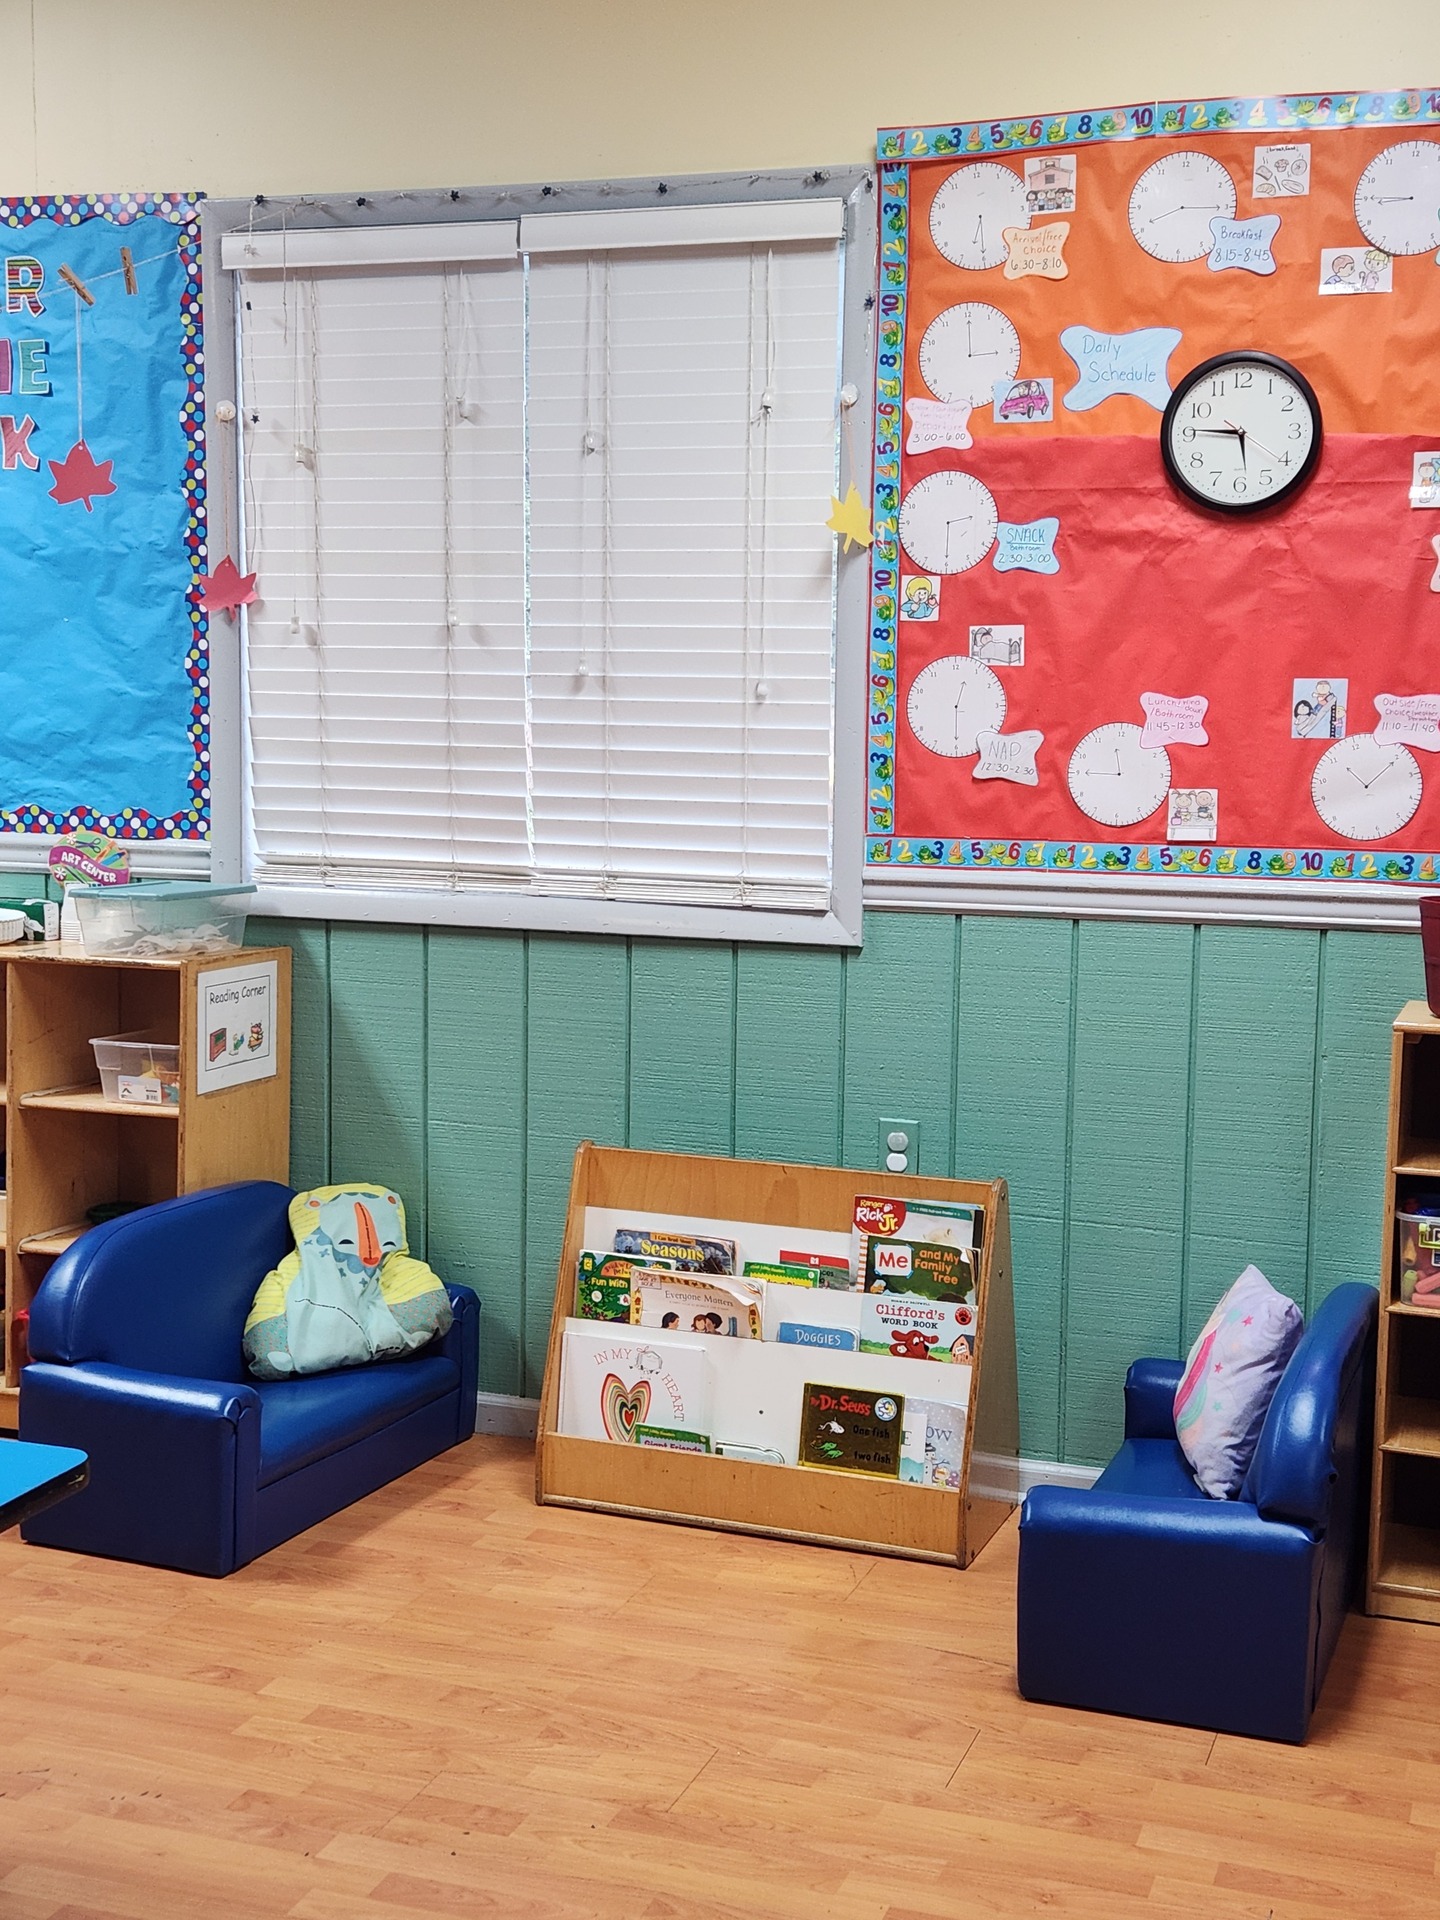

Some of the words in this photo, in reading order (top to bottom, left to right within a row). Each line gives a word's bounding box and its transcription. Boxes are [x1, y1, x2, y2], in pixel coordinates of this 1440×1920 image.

[1176, 104, 1187, 125] 1
[1192, 104, 1208, 124] 2
[1231, 101, 1245, 121] 3
[1251, 100, 1265, 118] 4
[1276, 99, 1290, 119] 5
[1317, 97, 1333, 117] 6
[1346, 95, 1360, 116] 7
[1370, 96, 1384, 115] 8
[1407, 93, 1421, 113] 9
[896, 131, 906, 152] 1
[911, 131, 927, 150] 2
[950, 127, 963, 147] 3
[967, 125, 980, 144] 4
[990, 123, 1004, 144] 5
[1029, 119, 1043, 139] 6
[1056, 116, 1068, 136] 7
[1078, 115, 1092, 134] 8
[1114, 110, 1127, 129] 9
[1131, 107, 1153, 128] 10
[1220, 225, 1263, 240] Breakfast
[5, 256, 46, 317] R
[1082, 334, 1121, 360] Daily
[1088, 361, 1156, 384] Schedule
[1234, 372, 1253, 389] 12
[1211, 381, 1225, 397] 11
[1268, 379, 1273, 395] 1
[1192, 402, 1212, 419] 10
[1281, 395, 1294, 412] 2
[1182, 426, 1196, 443] 9
[1287, 423, 1301, 440] 3
[1190, 452, 1203, 468] 8
[1278, 450, 1292, 466] 4
[1209, 471, 1223, 487] 7
[1233, 476, 1247, 493] 6
[1259, 469, 1273, 486] 5
[1007, 527, 1045, 543] SNACK
[875, 569, 892, 590] 10
[873, 595, 889, 608] 9
[873, 628, 890, 641] 8
[871, 650, 888, 664] 7
[871, 674, 888, 687] 6
[871, 712, 888, 725] 5
[871, 735, 886, 747] 4
[870, 752, 888, 766] 3
[988, 740, 1022, 761] NAP
[870, 784, 889, 800] 2
[870, 806, 888, 816] 1
[884, 840, 892, 857] 1
[898, 840, 911, 858] 2
[931, 841, 944, 859] 3
[949, 841, 961, 859] 4
[971, 842, 984, 860] 5
[1008, 842, 1022, 860] 6
[1034, 842, 1046, 861] 7
[61, 852, 81, 865] ART
[81, 860, 117, 883] CENTER
[1067, 845, 1076, 863] 1
[1082, 845, 1095, 863] 2
[1117, 846, 1131, 865] 3
[1137, 847, 1149, 864] 4
[1160, 847, 1173, 866] 5
[1199, 848, 1213, 865] 6
[1224, 849, 1238, 868] 7
[1248, 851, 1262, 869] 8
[1282, 851, 1296, 869] 9
[1300, 852, 1323, 871] 10
[1345, 853, 1355, 871] 1
[1361, 854, 1376, 873] 2
[1400, 855, 1415, 875] 3
[1420, 856, 1434, 874] 4
[210, 989, 239, 1004] Reading
[242, 986, 266, 998] Corner
[860, 1200, 884, 1208] Ranger
[856, 1207, 884, 1222] Rick
[878, 1214, 899, 1231] Jr.
[640, 1240, 705, 1262] Seasons
[878, 1252, 909, 1268] Me
[920, 1249, 941, 1260] and
[943, 1253, 959, 1264] My
[914, 1258, 952, 1275] Family
[591, 1277, 607, 1287] Fun
[608, 1279, 628, 1288] With
[933, 1272, 958, 1285] Tree
[665, 1290, 701, 1302] Everyone
[704, 1295, 734, 1307] Matters
[876, 1304, 945, 1321] Clifford's
[881, 1317, 908, 1326] WORD
[913, 1320, 938, 1329] BOOK
[795, 1329, 841, 1345] DOGGIES
[594, 1351, 608, 1365] IN
[612, 1348, 632, 1360] MY
[661, 1373, 685, 1422] HEART
[819, 1394, 838, 1410] Dr.
[842, 1395, 872, 1416] Seuss
[853, 1424, 869, 1435] One
[872, 1427, 890, 1439] fish
[873, 1454, 891, 1464] fish
